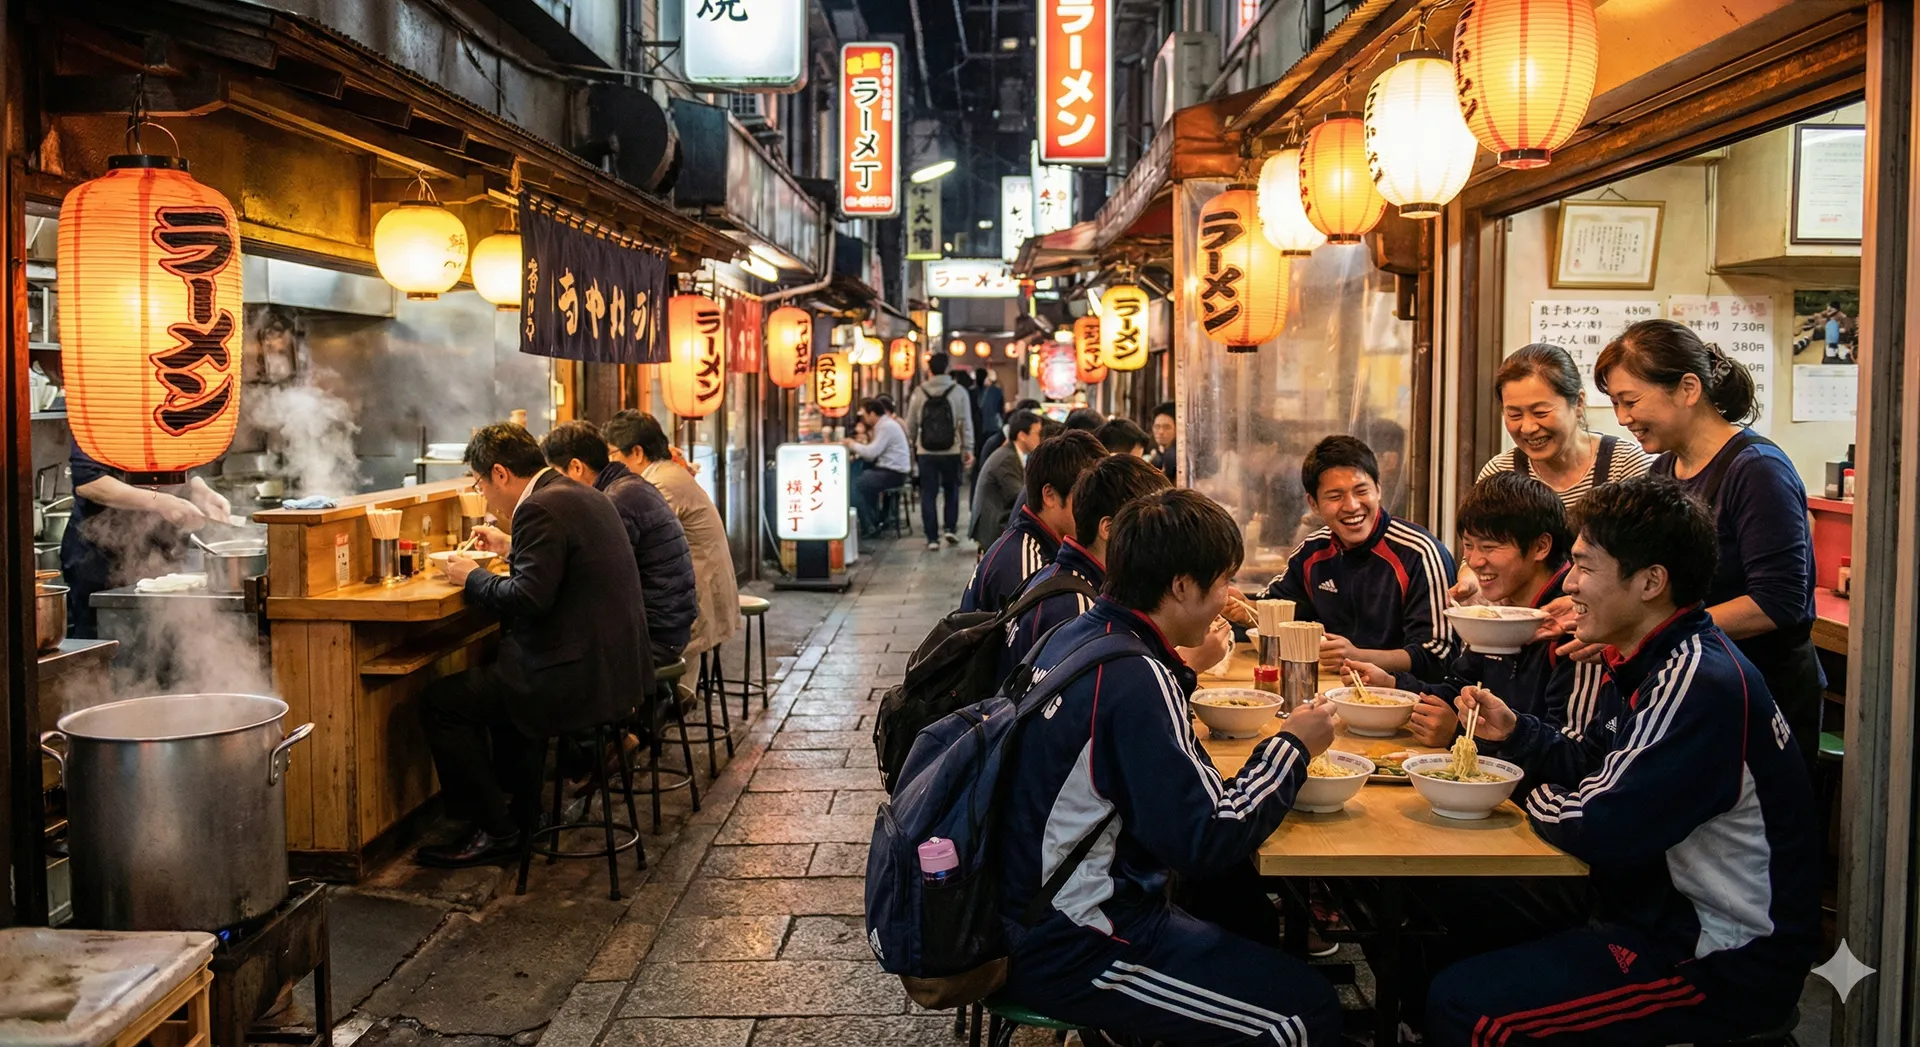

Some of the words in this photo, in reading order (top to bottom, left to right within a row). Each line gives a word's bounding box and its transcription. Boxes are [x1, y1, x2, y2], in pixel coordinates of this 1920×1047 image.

[1200, 209, 1246, 335] ラーメン
[150, 206, 237, 437] ラーメン
[1113, 298, 1141, 360] ラーメン
[1731, 322, 1765, 332] 730円
[1731, 342, 1765, 352] 380円
[696, 309, 721, 402] ラーメン
[808, 453, 824, 512] ラーメン
